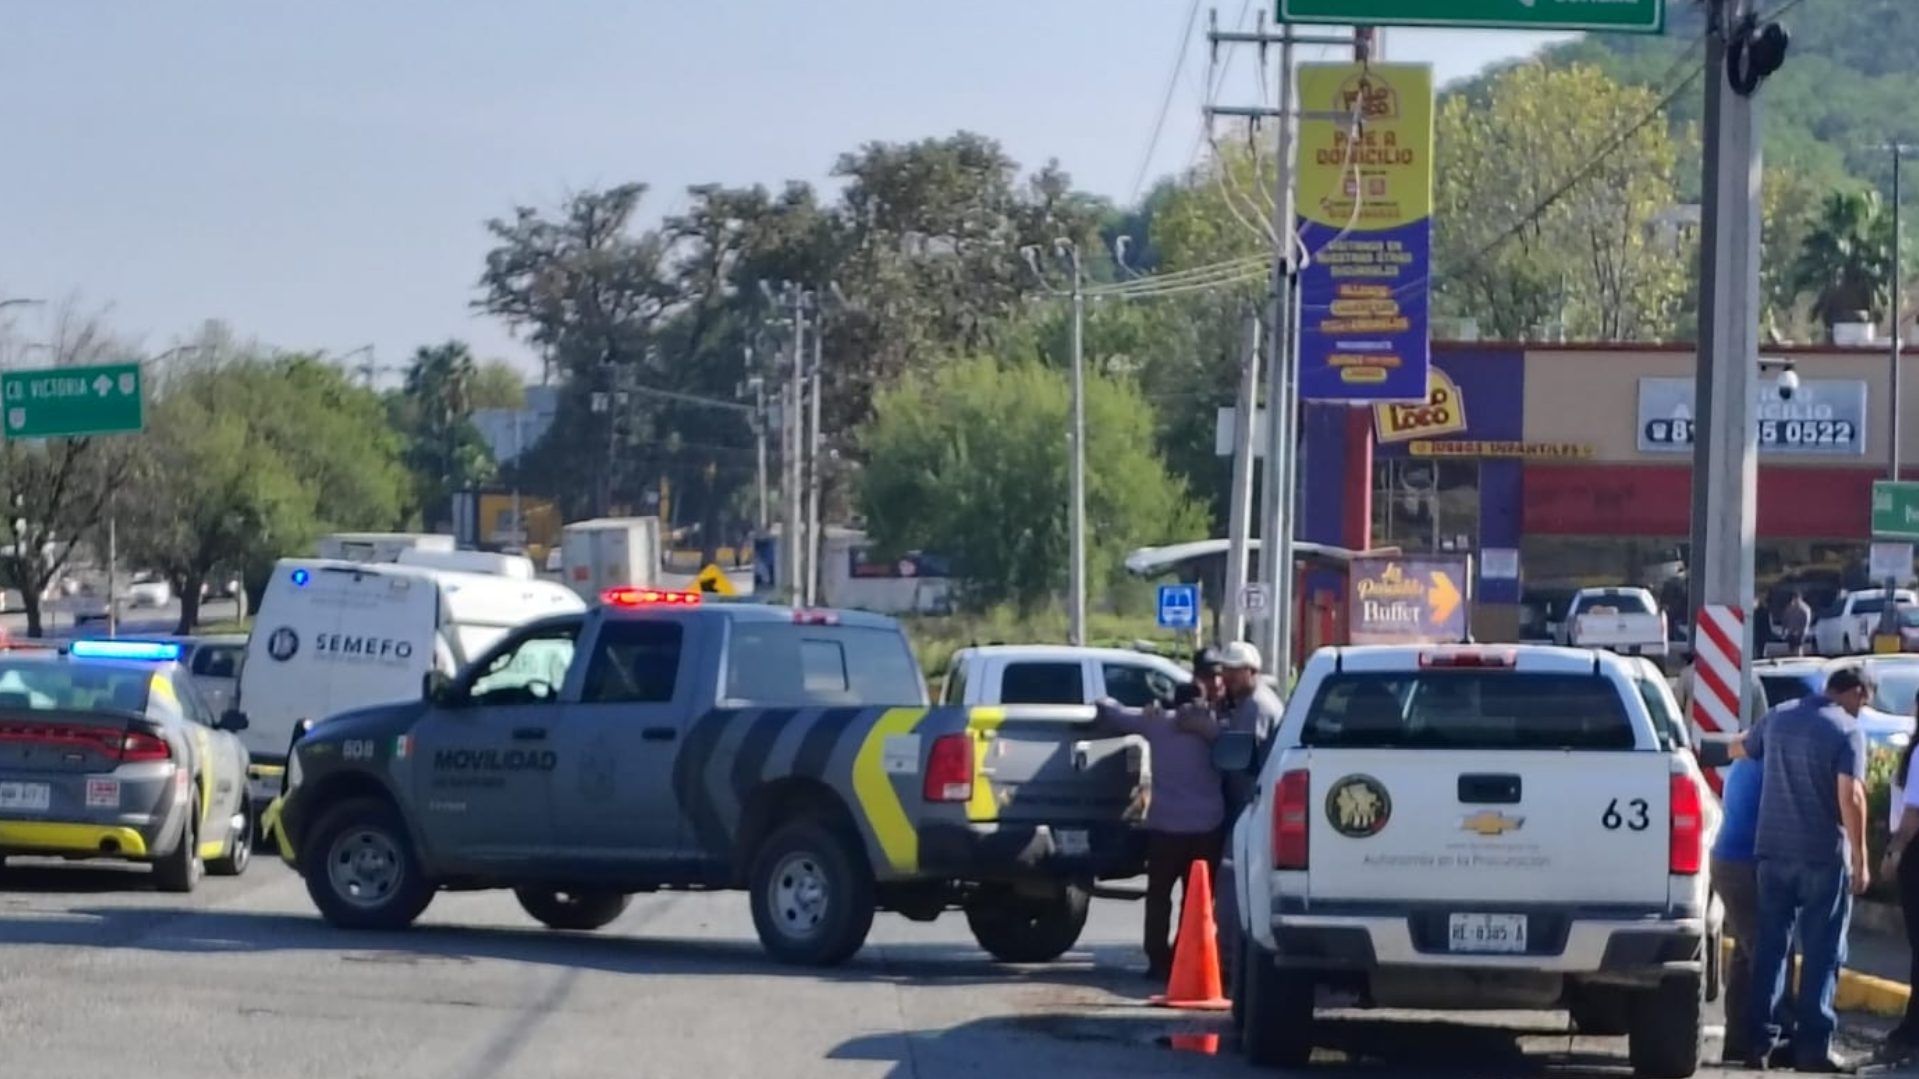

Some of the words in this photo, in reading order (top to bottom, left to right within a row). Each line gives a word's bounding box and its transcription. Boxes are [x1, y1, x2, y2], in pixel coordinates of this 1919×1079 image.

[1334, 131, 1376, 146] PE
[1384, 131, 1396, 146] A
[1316, 149, 1413, 165] DOMICILIO
[30, 378, 88, 398] VICTORIA
[1390, 403, 1450, 432] LOCO
[1785, 420, 1851, 442] 0522
[316, 634, 412, 658] SEMEFO
[434, 750, 557, 772] MOVILIDAD
[1601, 798, 1650, 831] 63
